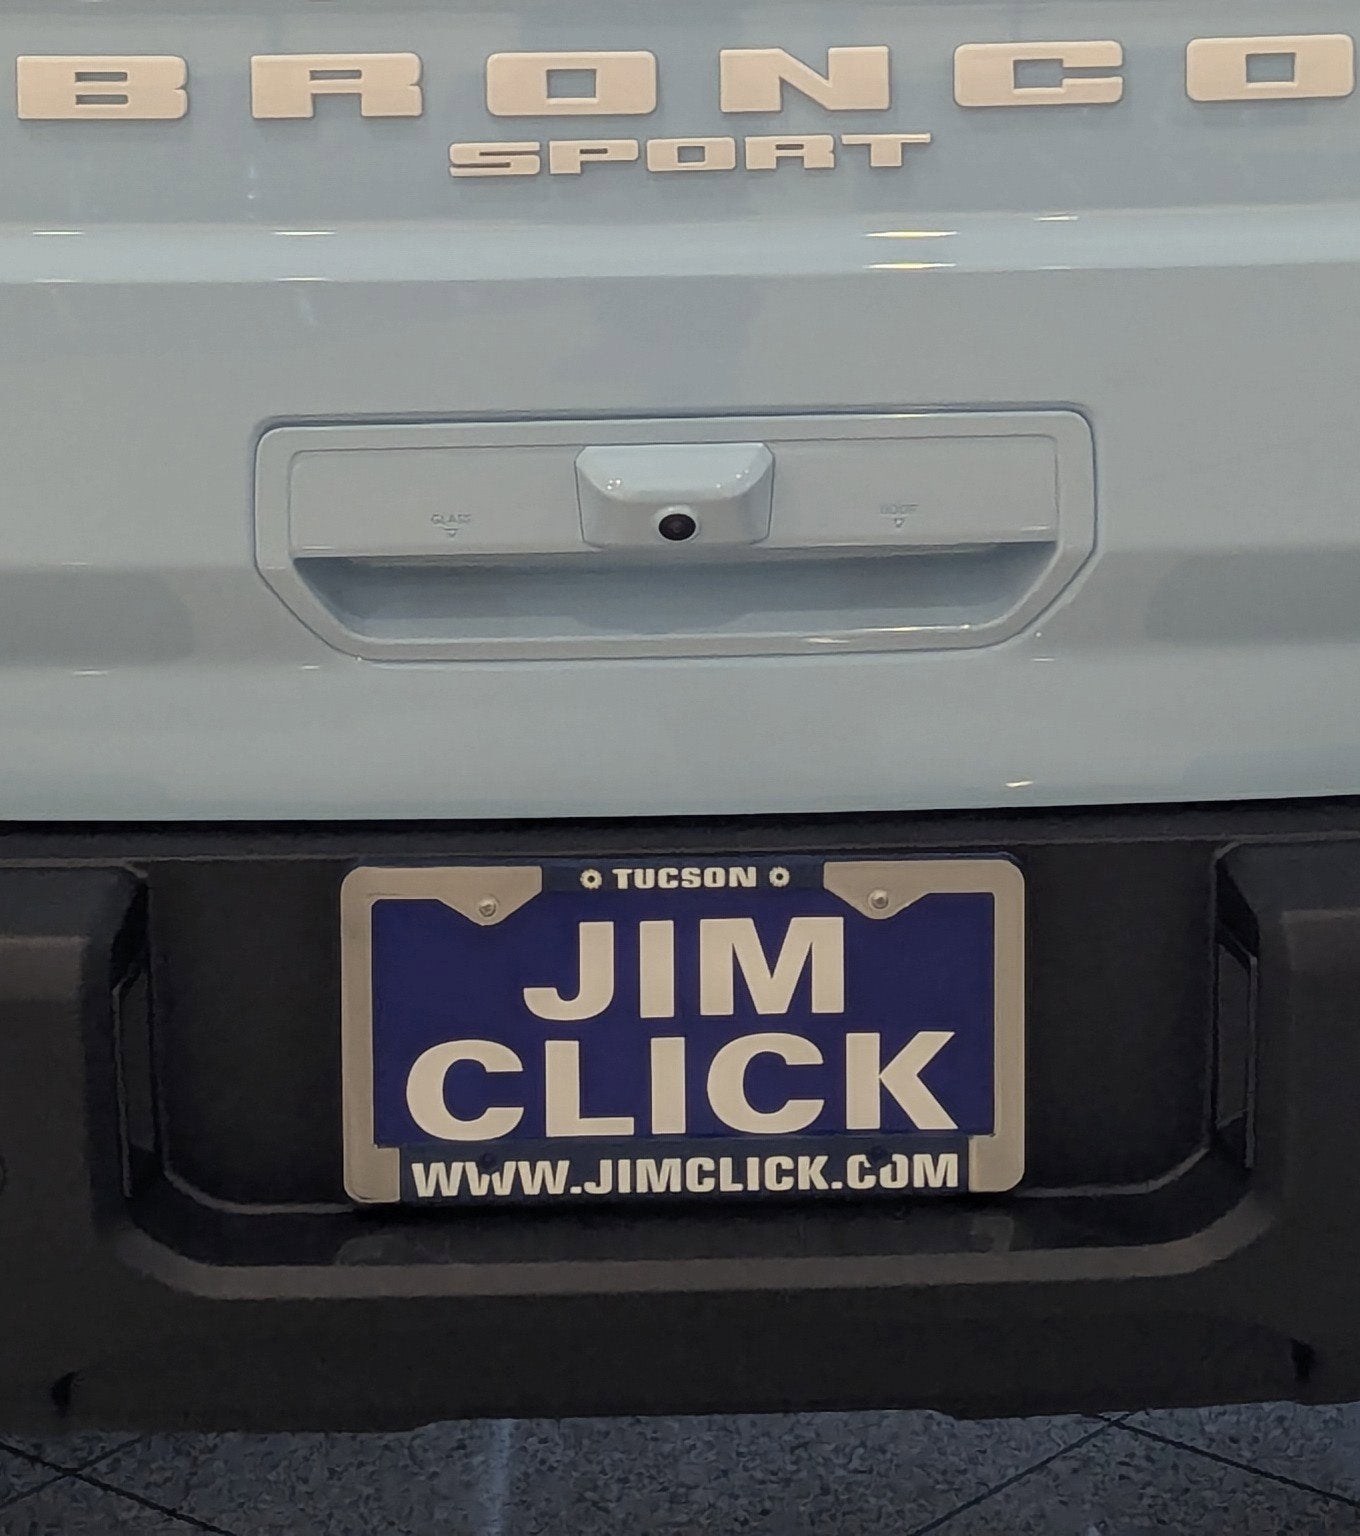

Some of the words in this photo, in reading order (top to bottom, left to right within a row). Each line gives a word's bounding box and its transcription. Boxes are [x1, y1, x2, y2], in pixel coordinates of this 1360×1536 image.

[16, 33, 1355, 120] BRONCO
[448, 132, 932, 178] SPORT
[612, 867, 758, 890] TUCSON
[523, 916, 845, 1022] JIM
[406, 1031, 959, 1142] CLICK
[411, 1152, 959, 1199] WWW.JIMCLICK.COM
